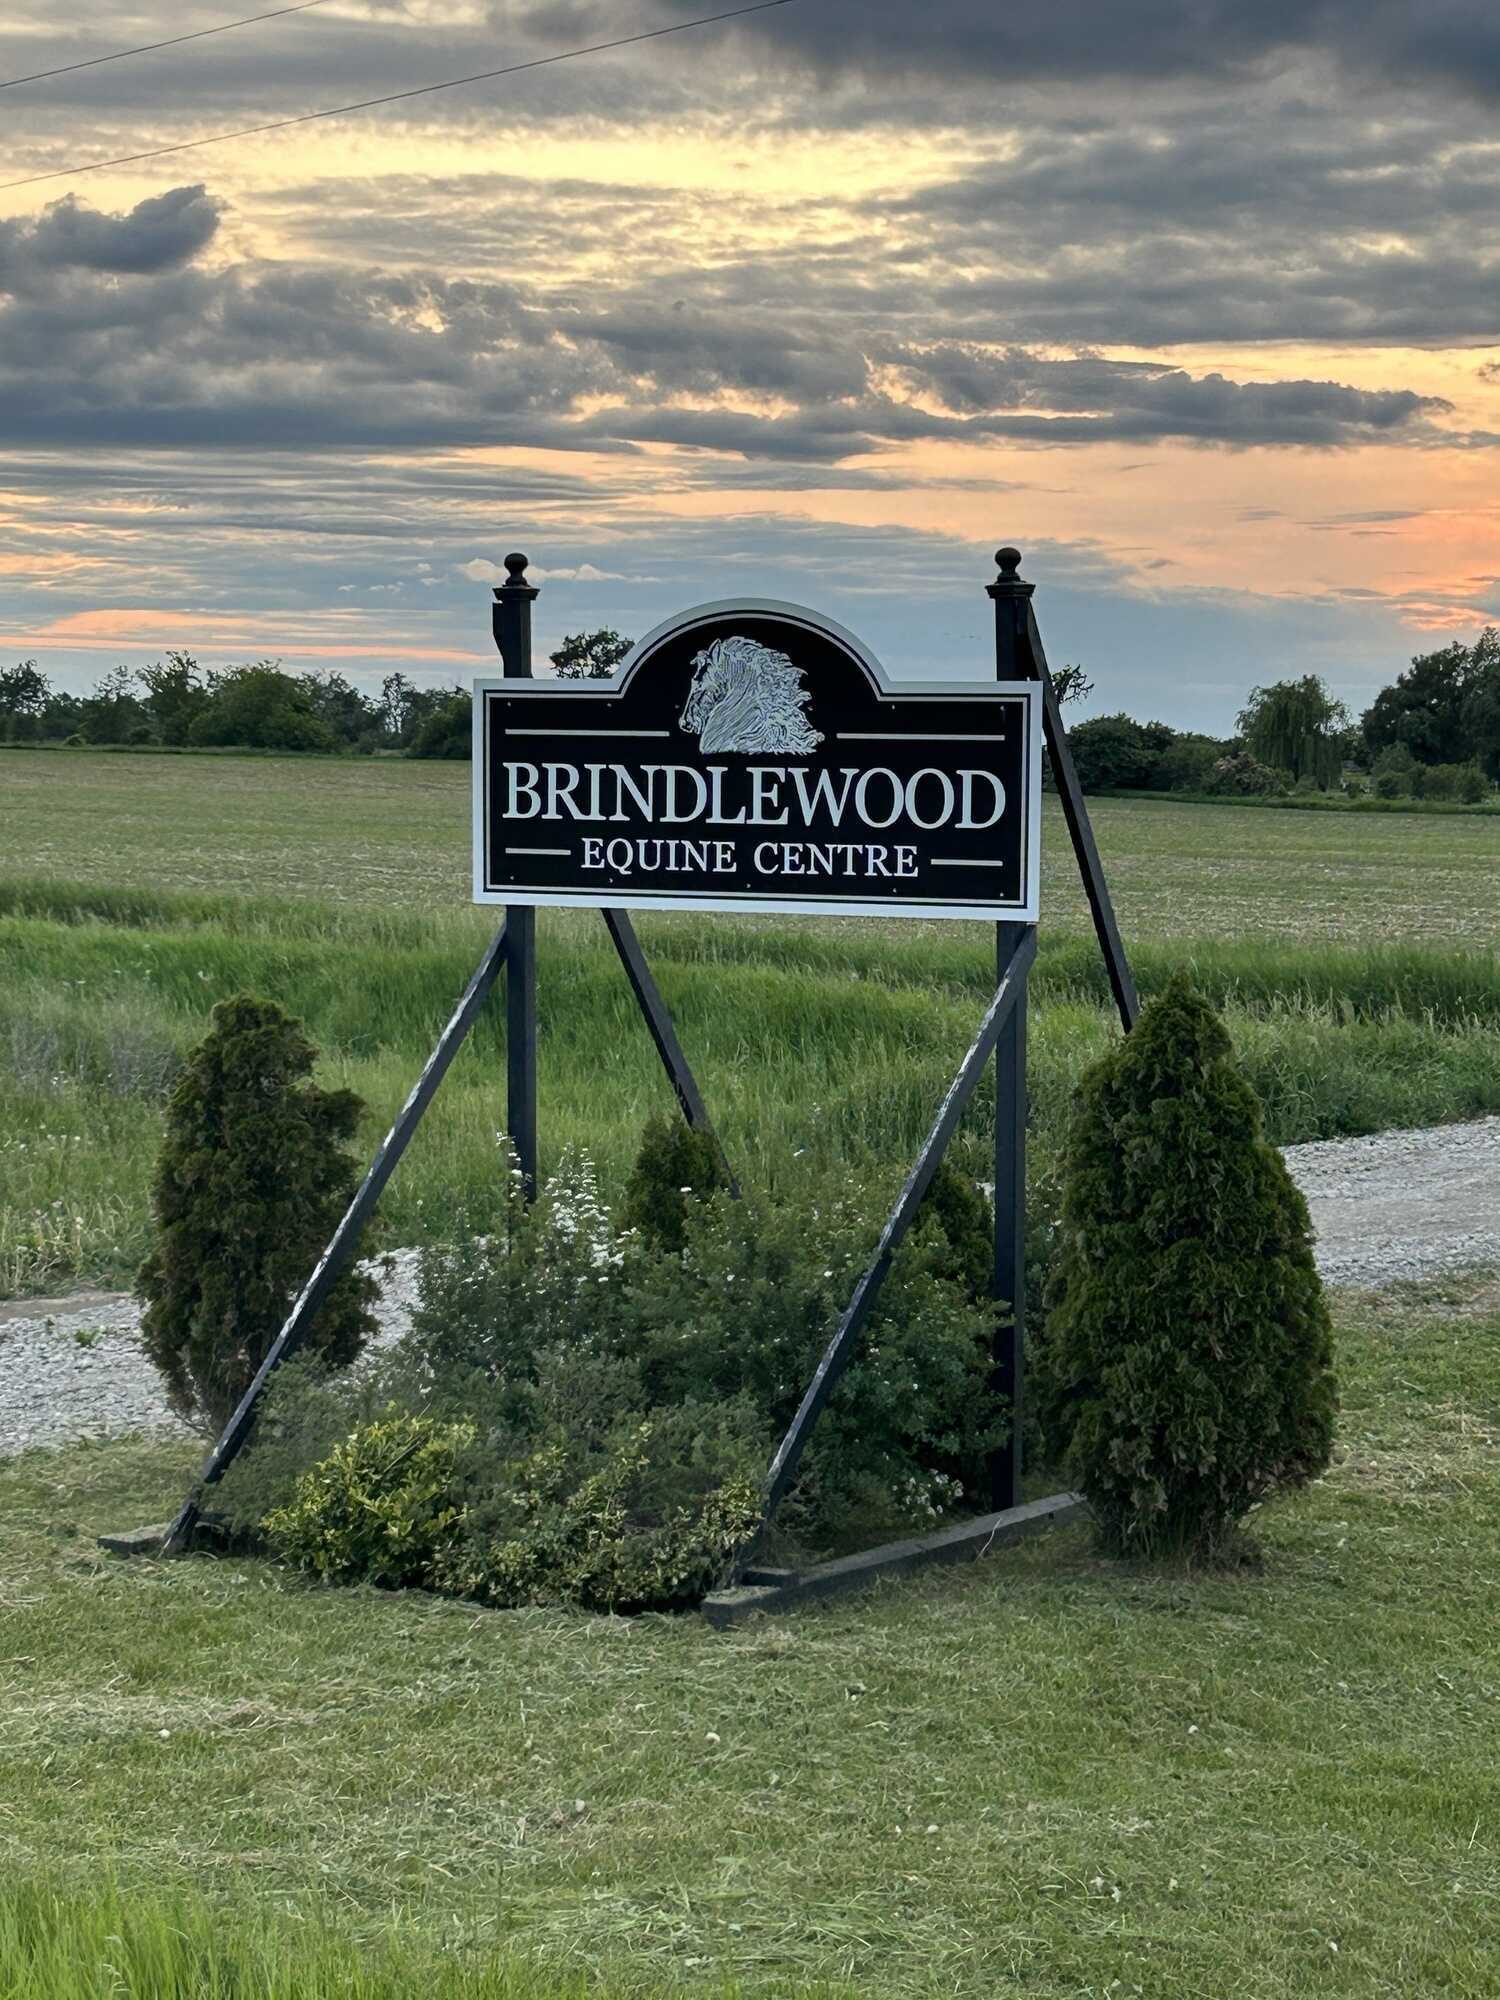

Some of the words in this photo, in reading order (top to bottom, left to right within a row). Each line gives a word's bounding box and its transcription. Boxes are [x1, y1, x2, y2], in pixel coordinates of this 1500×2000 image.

[503, 762, 1006, 830] BRINDLEWOOD
[580, 837, 737, 875] EQUINE
[753, 842, 919, 878] CENTRE
